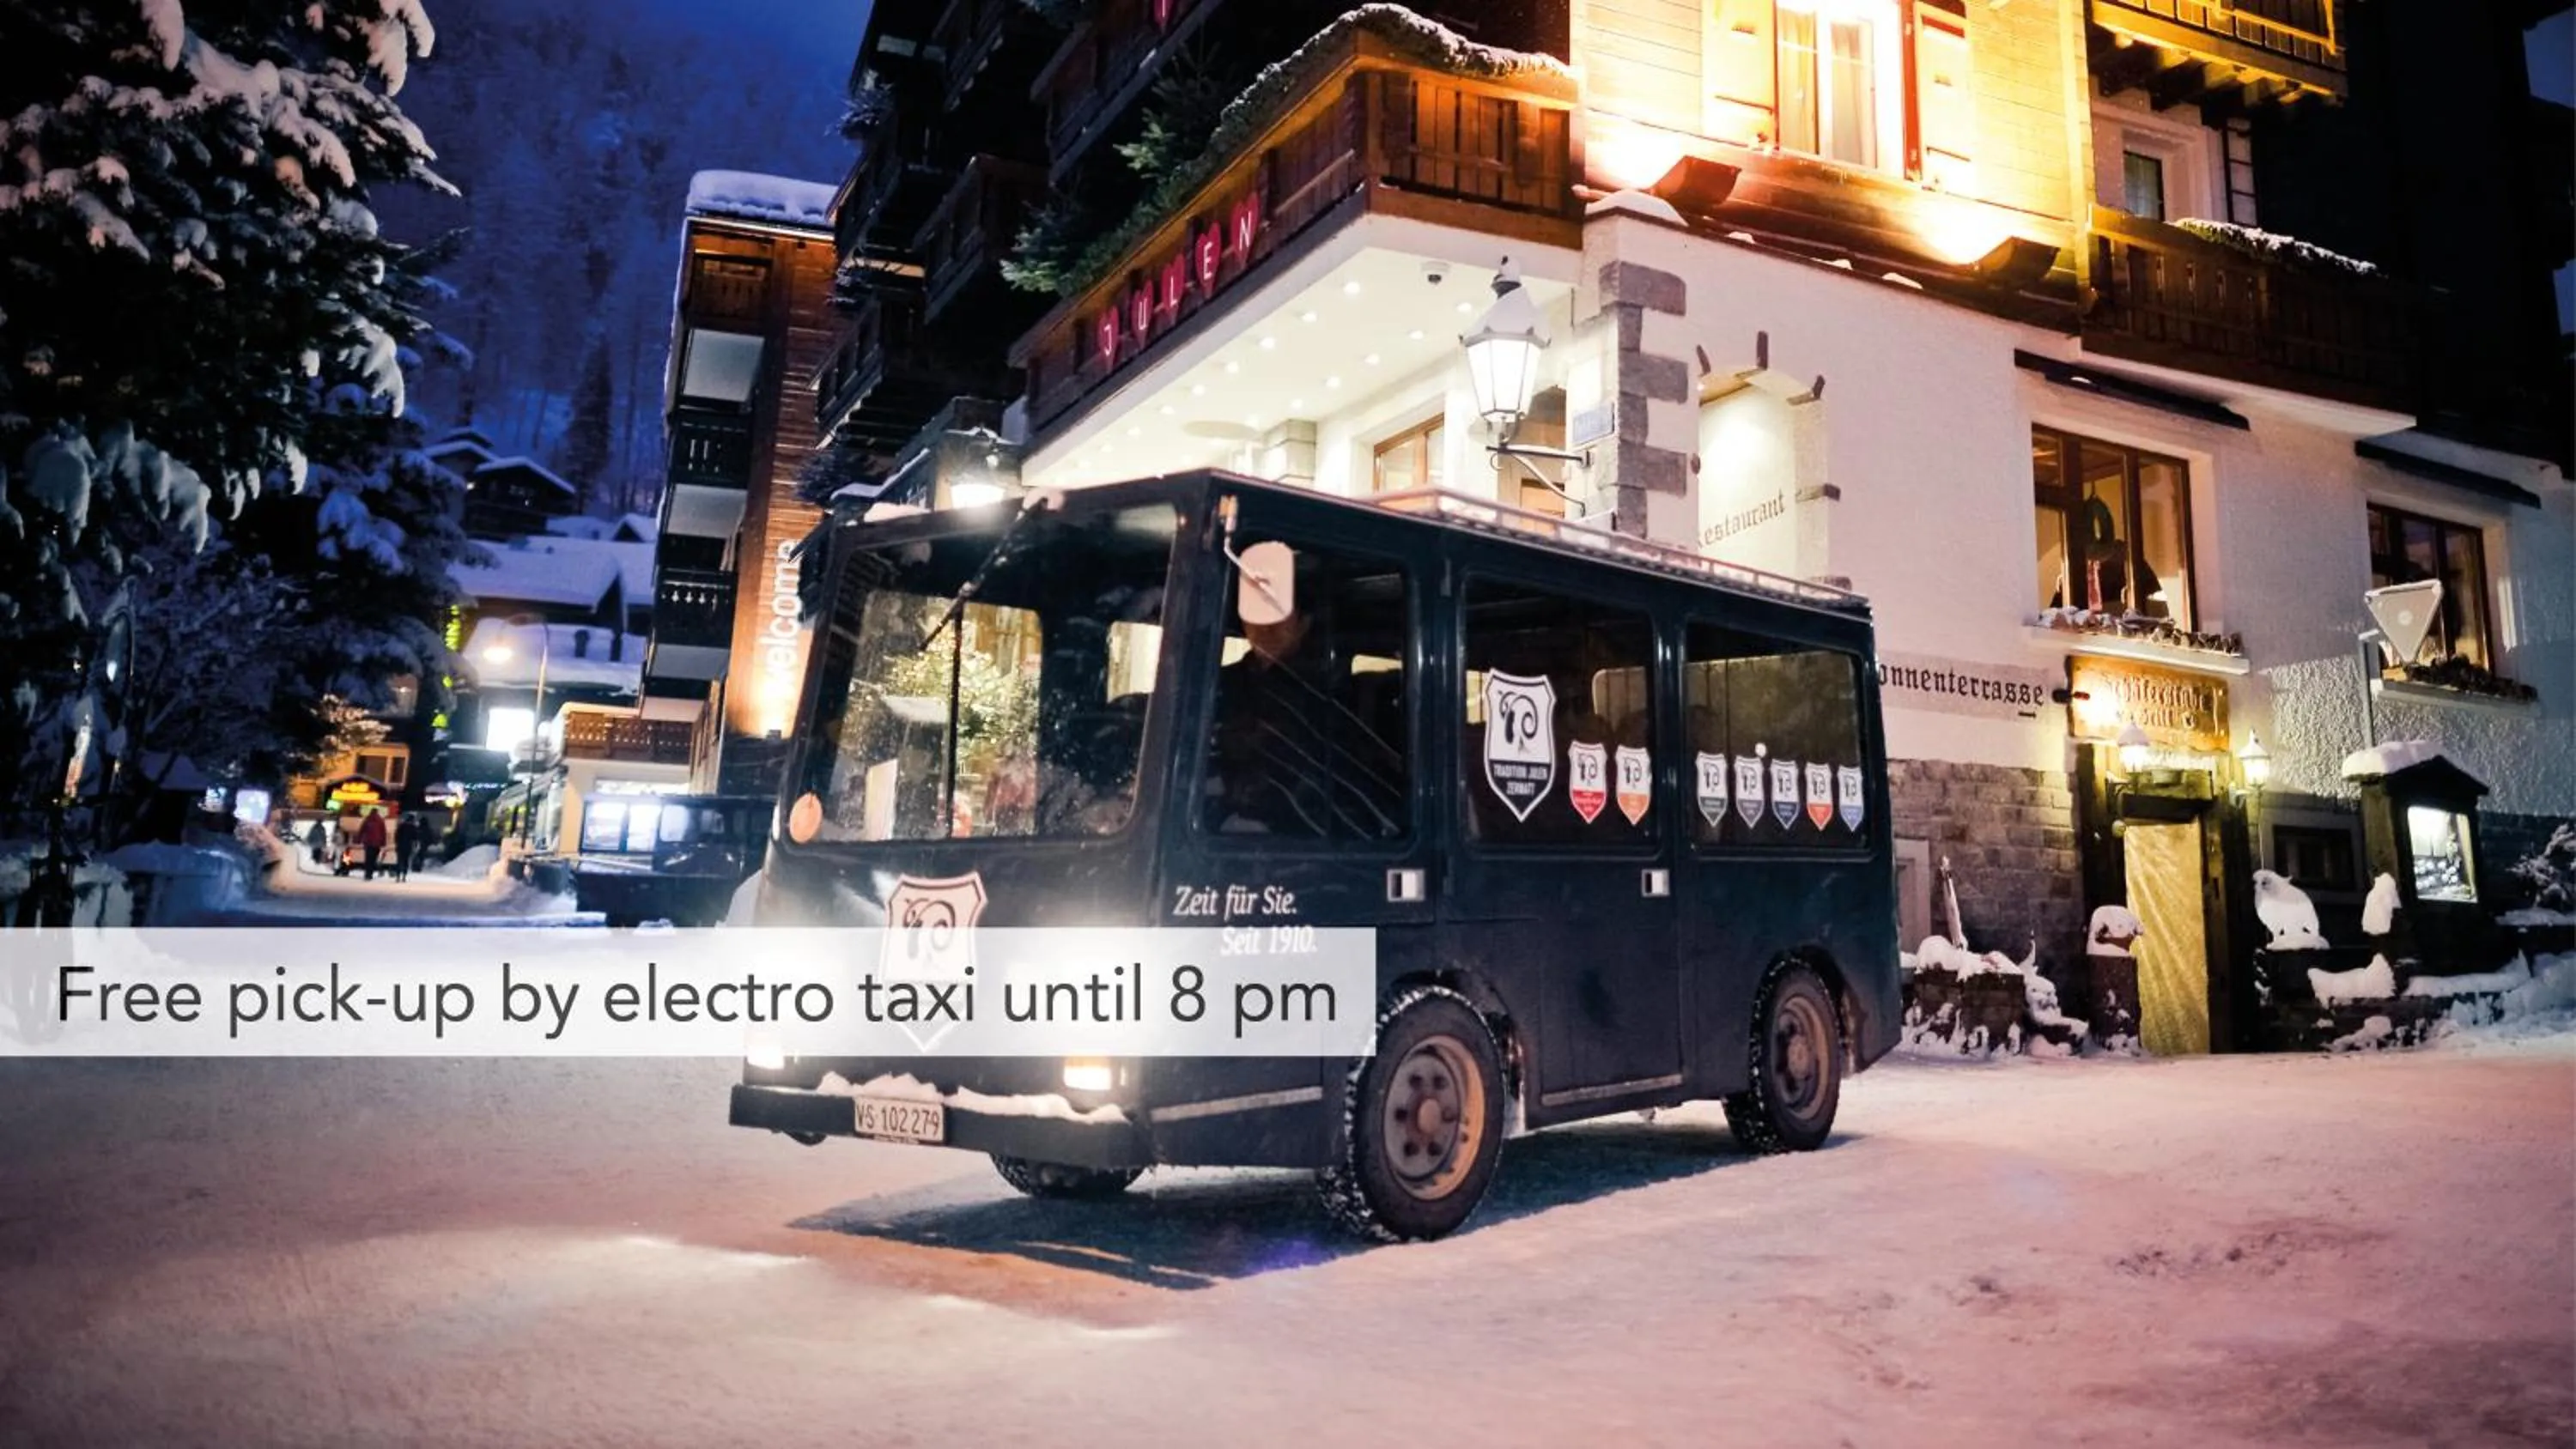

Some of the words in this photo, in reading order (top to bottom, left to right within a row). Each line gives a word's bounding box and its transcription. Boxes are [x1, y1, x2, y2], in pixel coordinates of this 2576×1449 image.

[1103, 210, 1252, 357] JULEN
[1173, 885, 1218, 916] Zeit
[1224, 883, 1258, 922] für
[1262, 885, 1297, 915] Sie.
[1221, 925, 1261, 956] Seit
[1269, 925, 1318, 954] 1910.
[857, 1104, 875, 1130] VS
